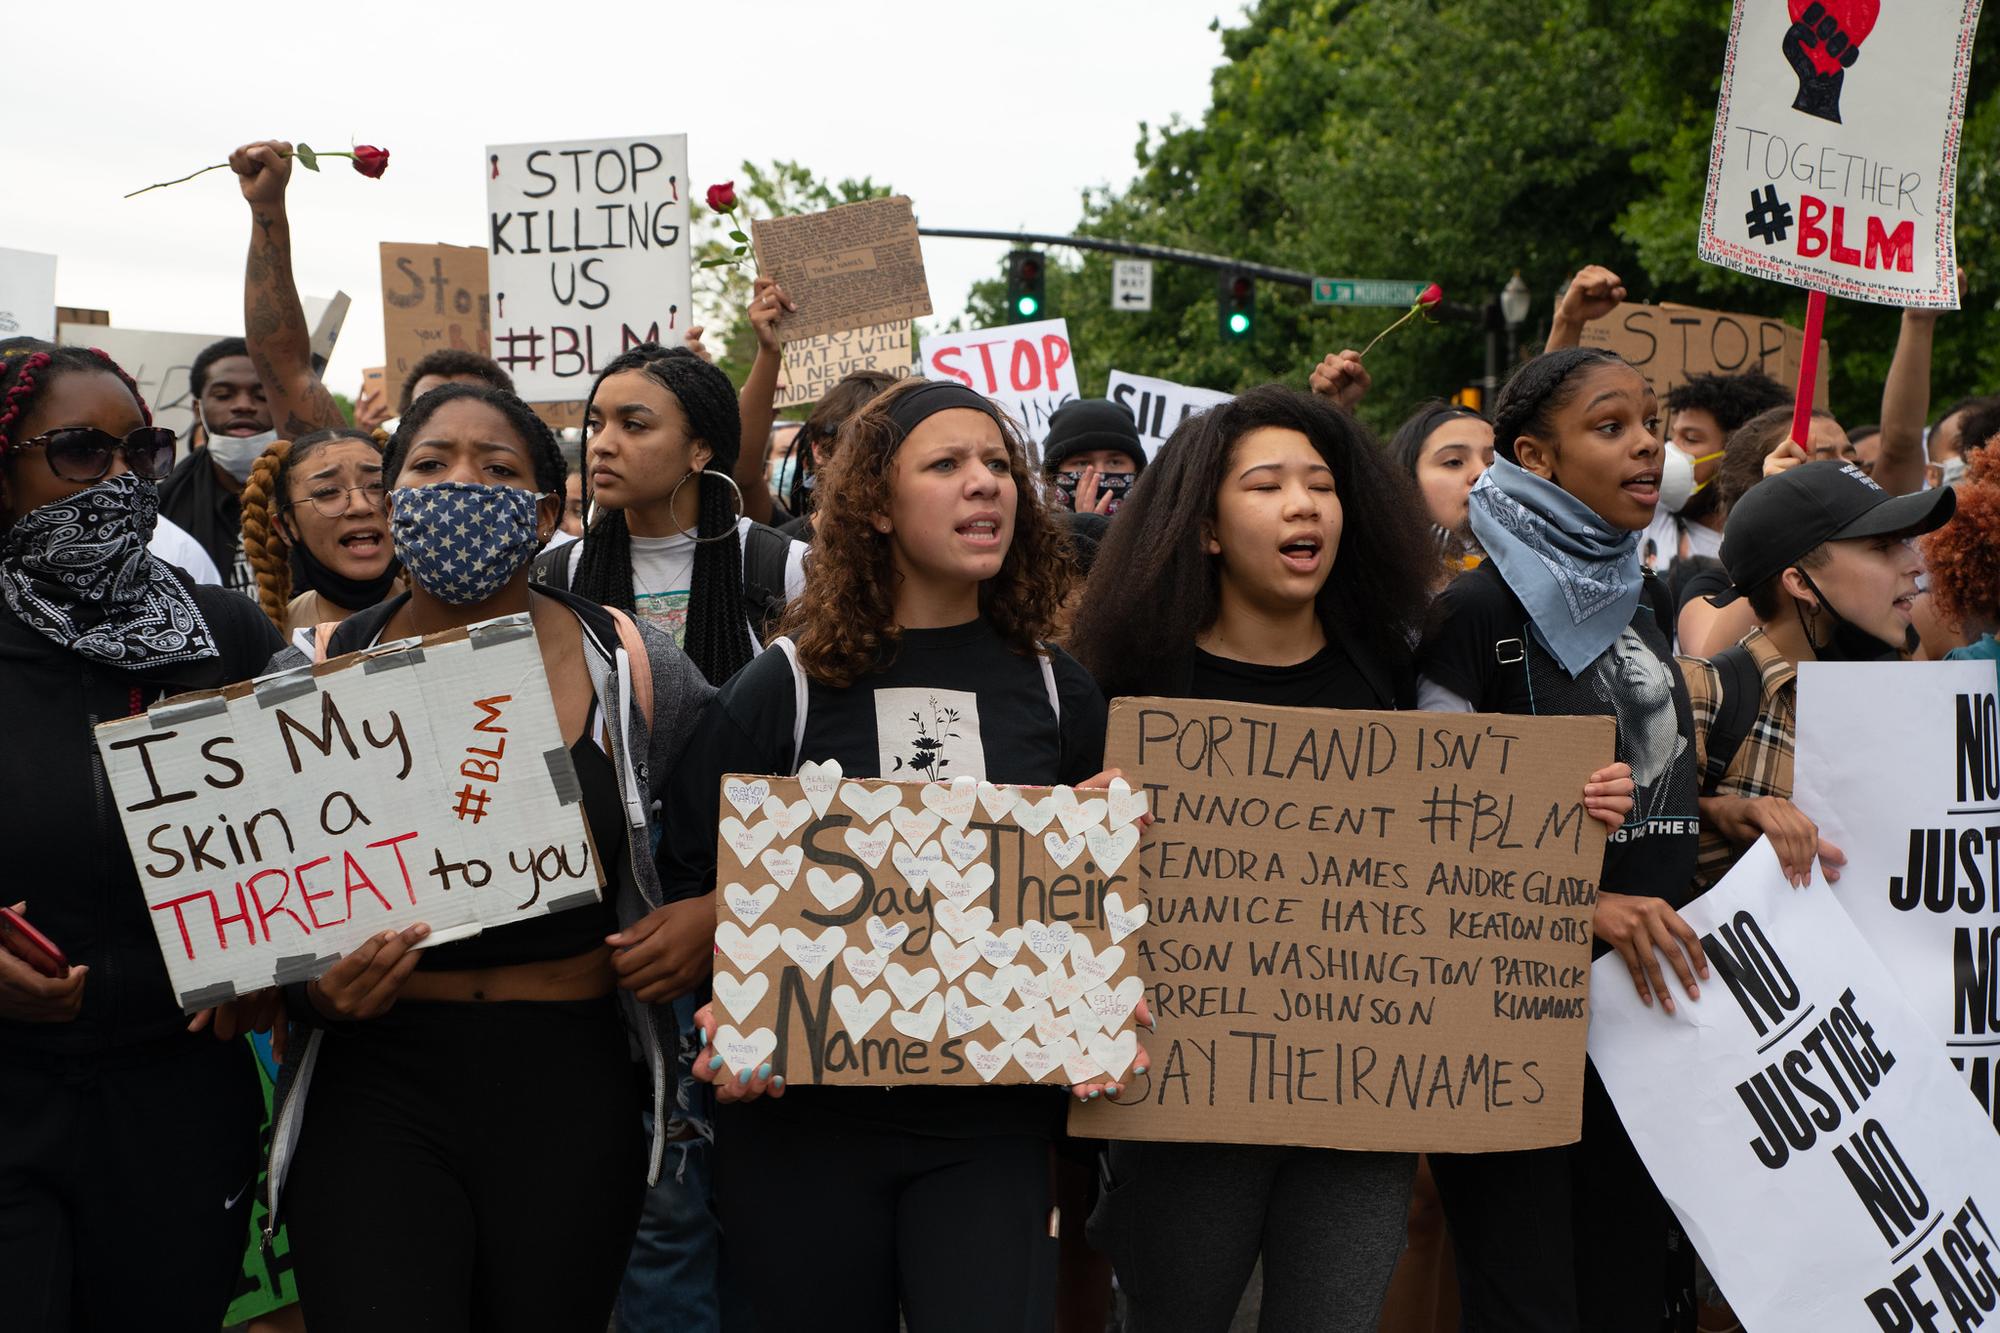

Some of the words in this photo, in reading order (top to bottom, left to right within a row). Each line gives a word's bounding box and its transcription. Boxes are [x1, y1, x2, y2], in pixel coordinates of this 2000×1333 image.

[523, 142, 664, 200] STOP
[1735, 125, 1923, 216] TOGETHER
[491, 201, 682, 255] KILLING
[1744, 183, 1915, 274] #BLM
[551, 258, 610, 310] US
[1120, 264, 1145, 276] ONE
[1120, 278, 1146, 289] WAY
[1699, 247, 1722, 264] BLACK
[1725, 256, 1742, 271] LIVES
[1746, 266, 1782, 281] MATTER
[1839, 289, 1871, 299] MATTER
[784, 345, 832, 369] HAT
[839, 343, 851, 360] I
[858, 333, 910, 354] WILL
[807, 355, 877, 381] NEVER
[932, 334, 1070, 394] STOP
[1624, 311, 1786, 373] STOP
[110, 731, 245, 812] Is
[276, 690, 414, 781] My
[453, 694, 513, 825] #BLM
[1138, 709, 1397, 782] PORTLAND
[1416, 726, 1519, 775] ISN'T
[1955, 693, 2000, 803] NO
[320, 791, 373, 836] a
[1142, 783, 1397, 838] INNOCENT
[1418, 784, 1585, 854] #BLM
[1648, 821, 1684, 834] THE
[151, 831, 419, 960] THREAT
[429, 847, 492, 891] to
[800, 814, 934, 957] Say
[969, 821, 1128, 931] Their
[1300, 852, 1409, 889] JAMES
[1426, 862, 1515, 900] ANDRE
[1522, 871, 1599, 907] GLADEN
[1031, 930, 1070, 941] GEORGE
[1033, 943, 1066, 954] FLOYD
[1321, 898, 1427, 936] HAYES
[1449, 906, 1543, 942] KEATON
[1550, 918, 1590, 946] OTIS
[1138, 939, 1233, 977] ASON
[1249, 941, 1484, 988] WASHINGTON
[1491, 954, 1586, 990] PATRICK
[1701, 910, 1801, 1038] NO
[772, 961, 965, 1084] Names
[1094, 994, 1121, 1005] ERIC
[1095, 1006, 1128, 1016] GARNER
[1273, 986, 1436, 1026] JOHNSON
[1493, 989, 1585, 1021] KIMMONS
[1229, 1030, 1378, 1105] THEIR
[1386, 1054, 1545, 1112] NAMES
[1735, 987, 1897, 1171] JUSTICE
[1831, 1117, 1930, 1249] NO
